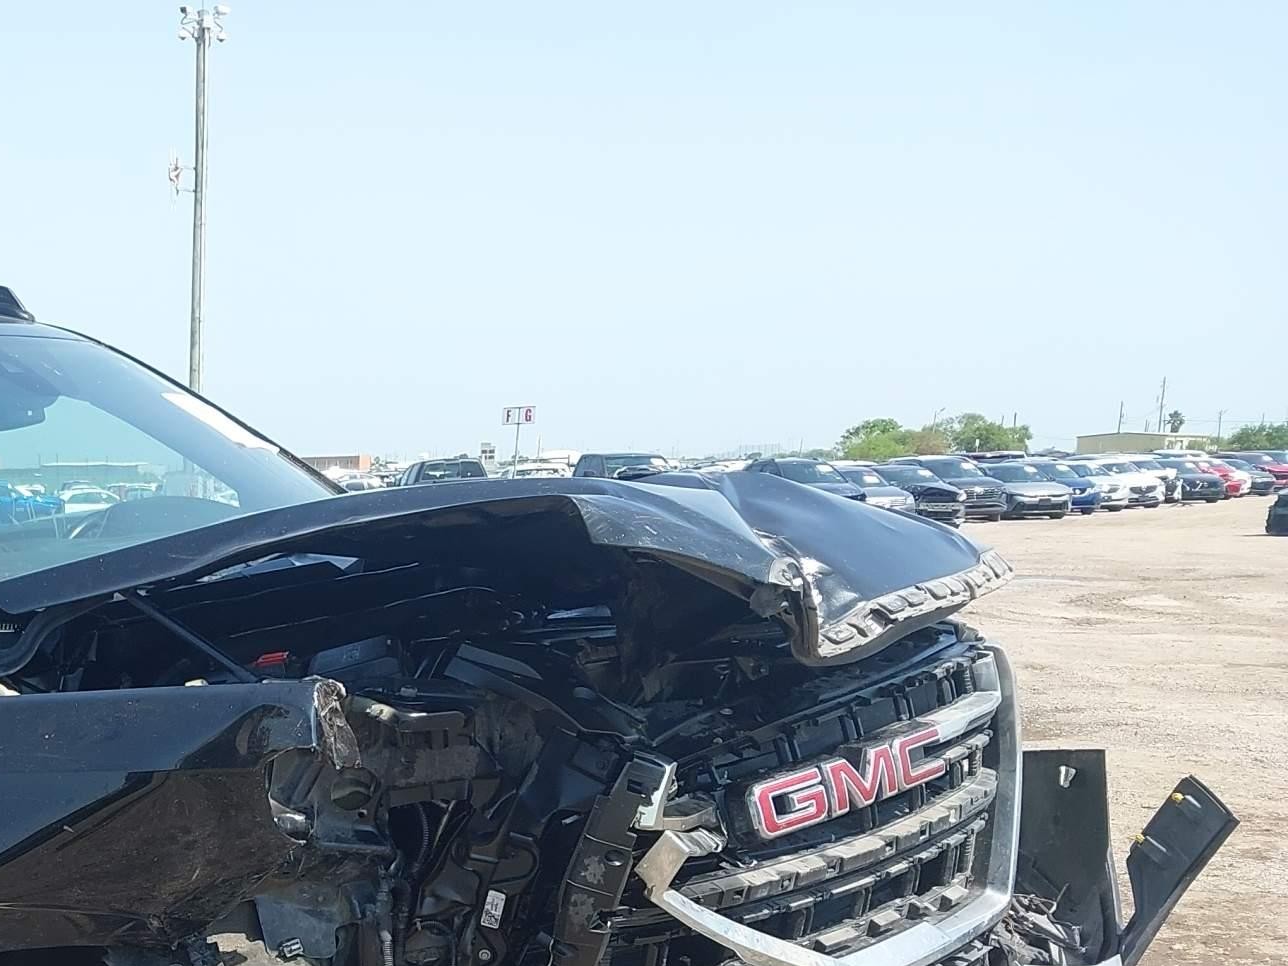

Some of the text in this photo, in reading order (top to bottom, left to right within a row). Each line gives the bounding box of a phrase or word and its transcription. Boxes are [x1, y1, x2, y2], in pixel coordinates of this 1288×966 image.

[506, 409, 512, 423] F
[524, 408, 532, 422] G
[752, 726, 946, 838] GMC
